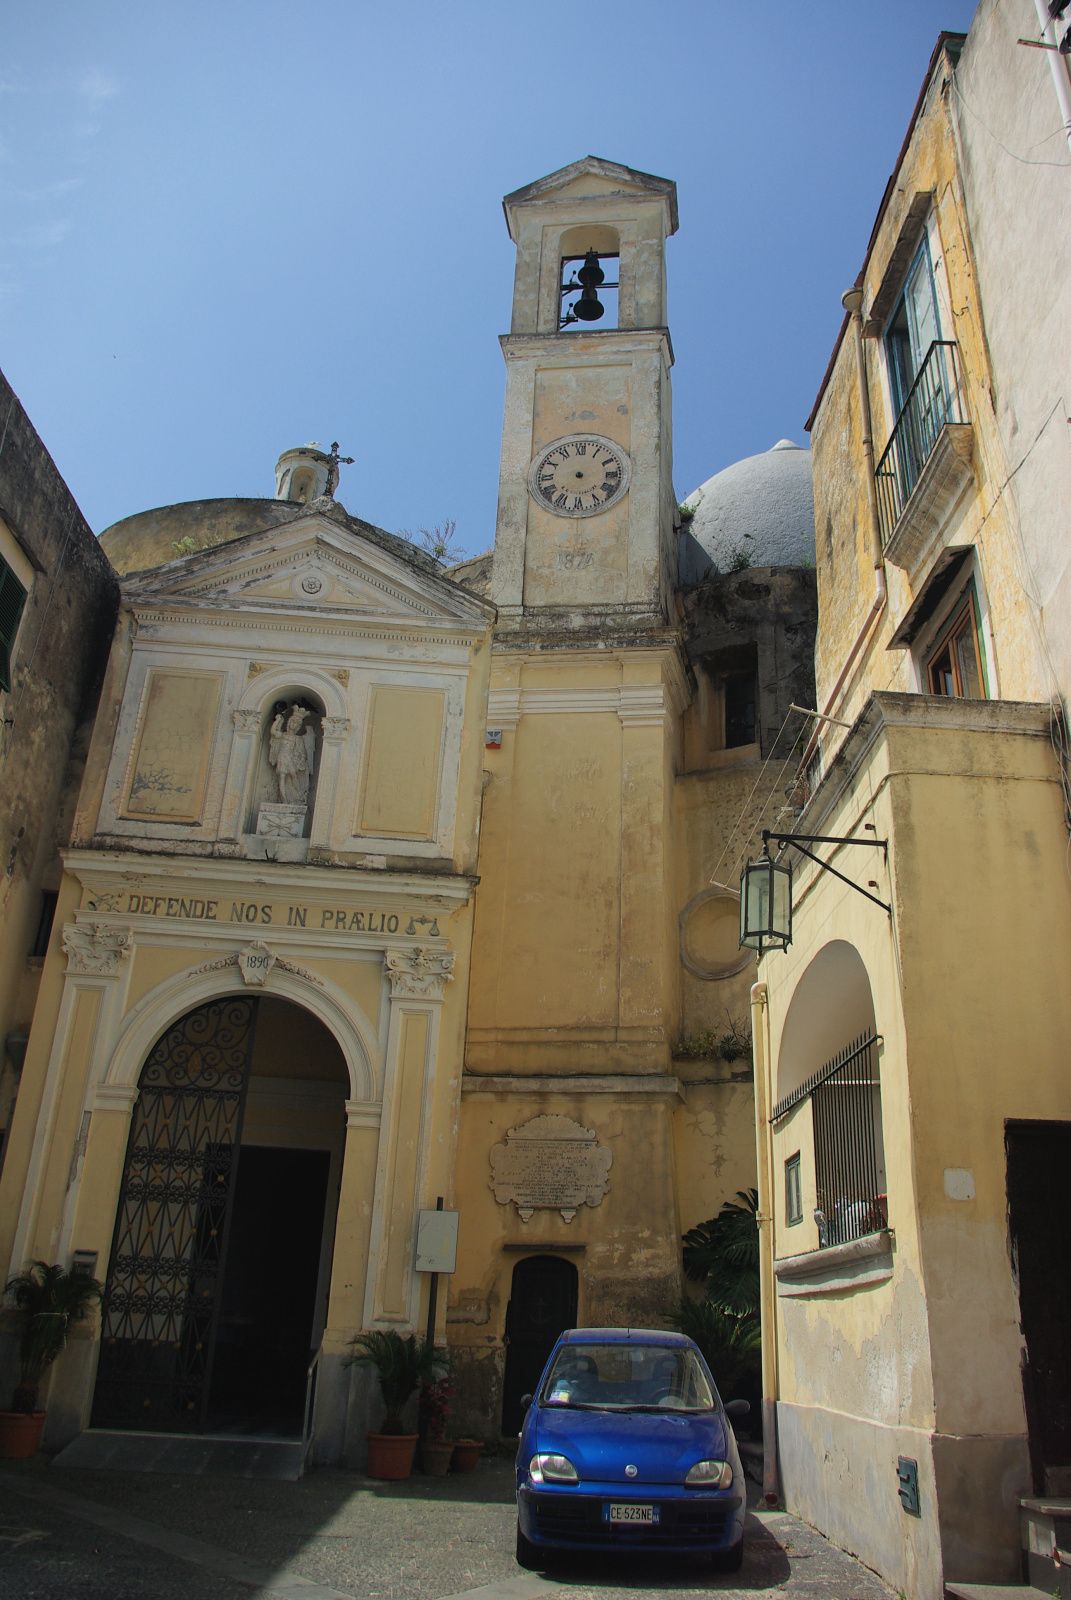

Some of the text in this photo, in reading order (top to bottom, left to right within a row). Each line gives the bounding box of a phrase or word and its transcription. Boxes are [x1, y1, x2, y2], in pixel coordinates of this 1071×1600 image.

[559, 449, 569, 461] XI
[575, 445, 587, 456] XII
[592, 449, 600, 458] I
[547, 460, 558, 470] X
[127, 894, 400, 934] DEFENDE NOS IN PRÆLIO
[245, 954, 269, 969] 1890
[611, 1507, 622, 1520] CE
[624, 1507, 652, 1521] 523NE
